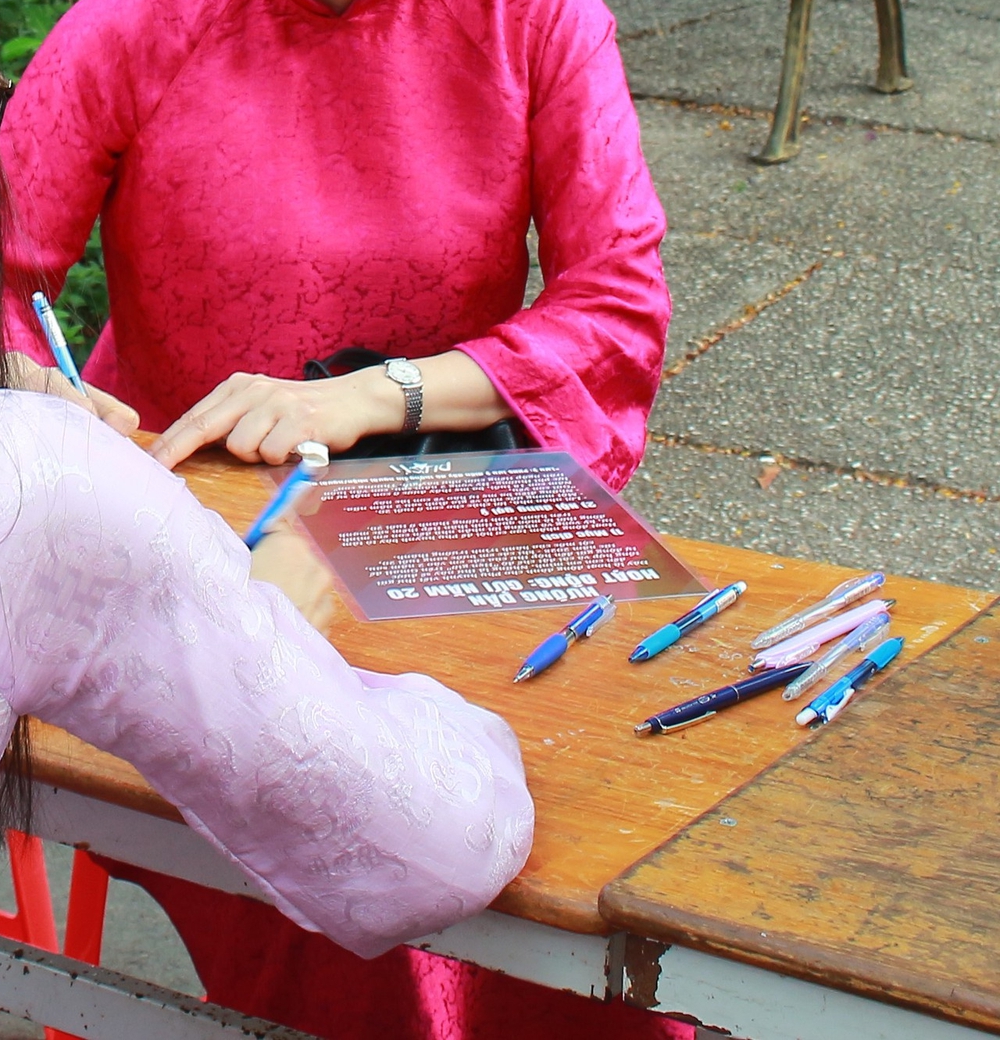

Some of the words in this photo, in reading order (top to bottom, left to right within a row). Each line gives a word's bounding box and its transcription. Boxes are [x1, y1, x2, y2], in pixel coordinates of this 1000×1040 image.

[601, 568, 660, 584] HOẠT
[386, 586, 420, 600] 20
[423, 582, 479, 598] NĂM
[519, 586, 600, 603] HƯỚNG
